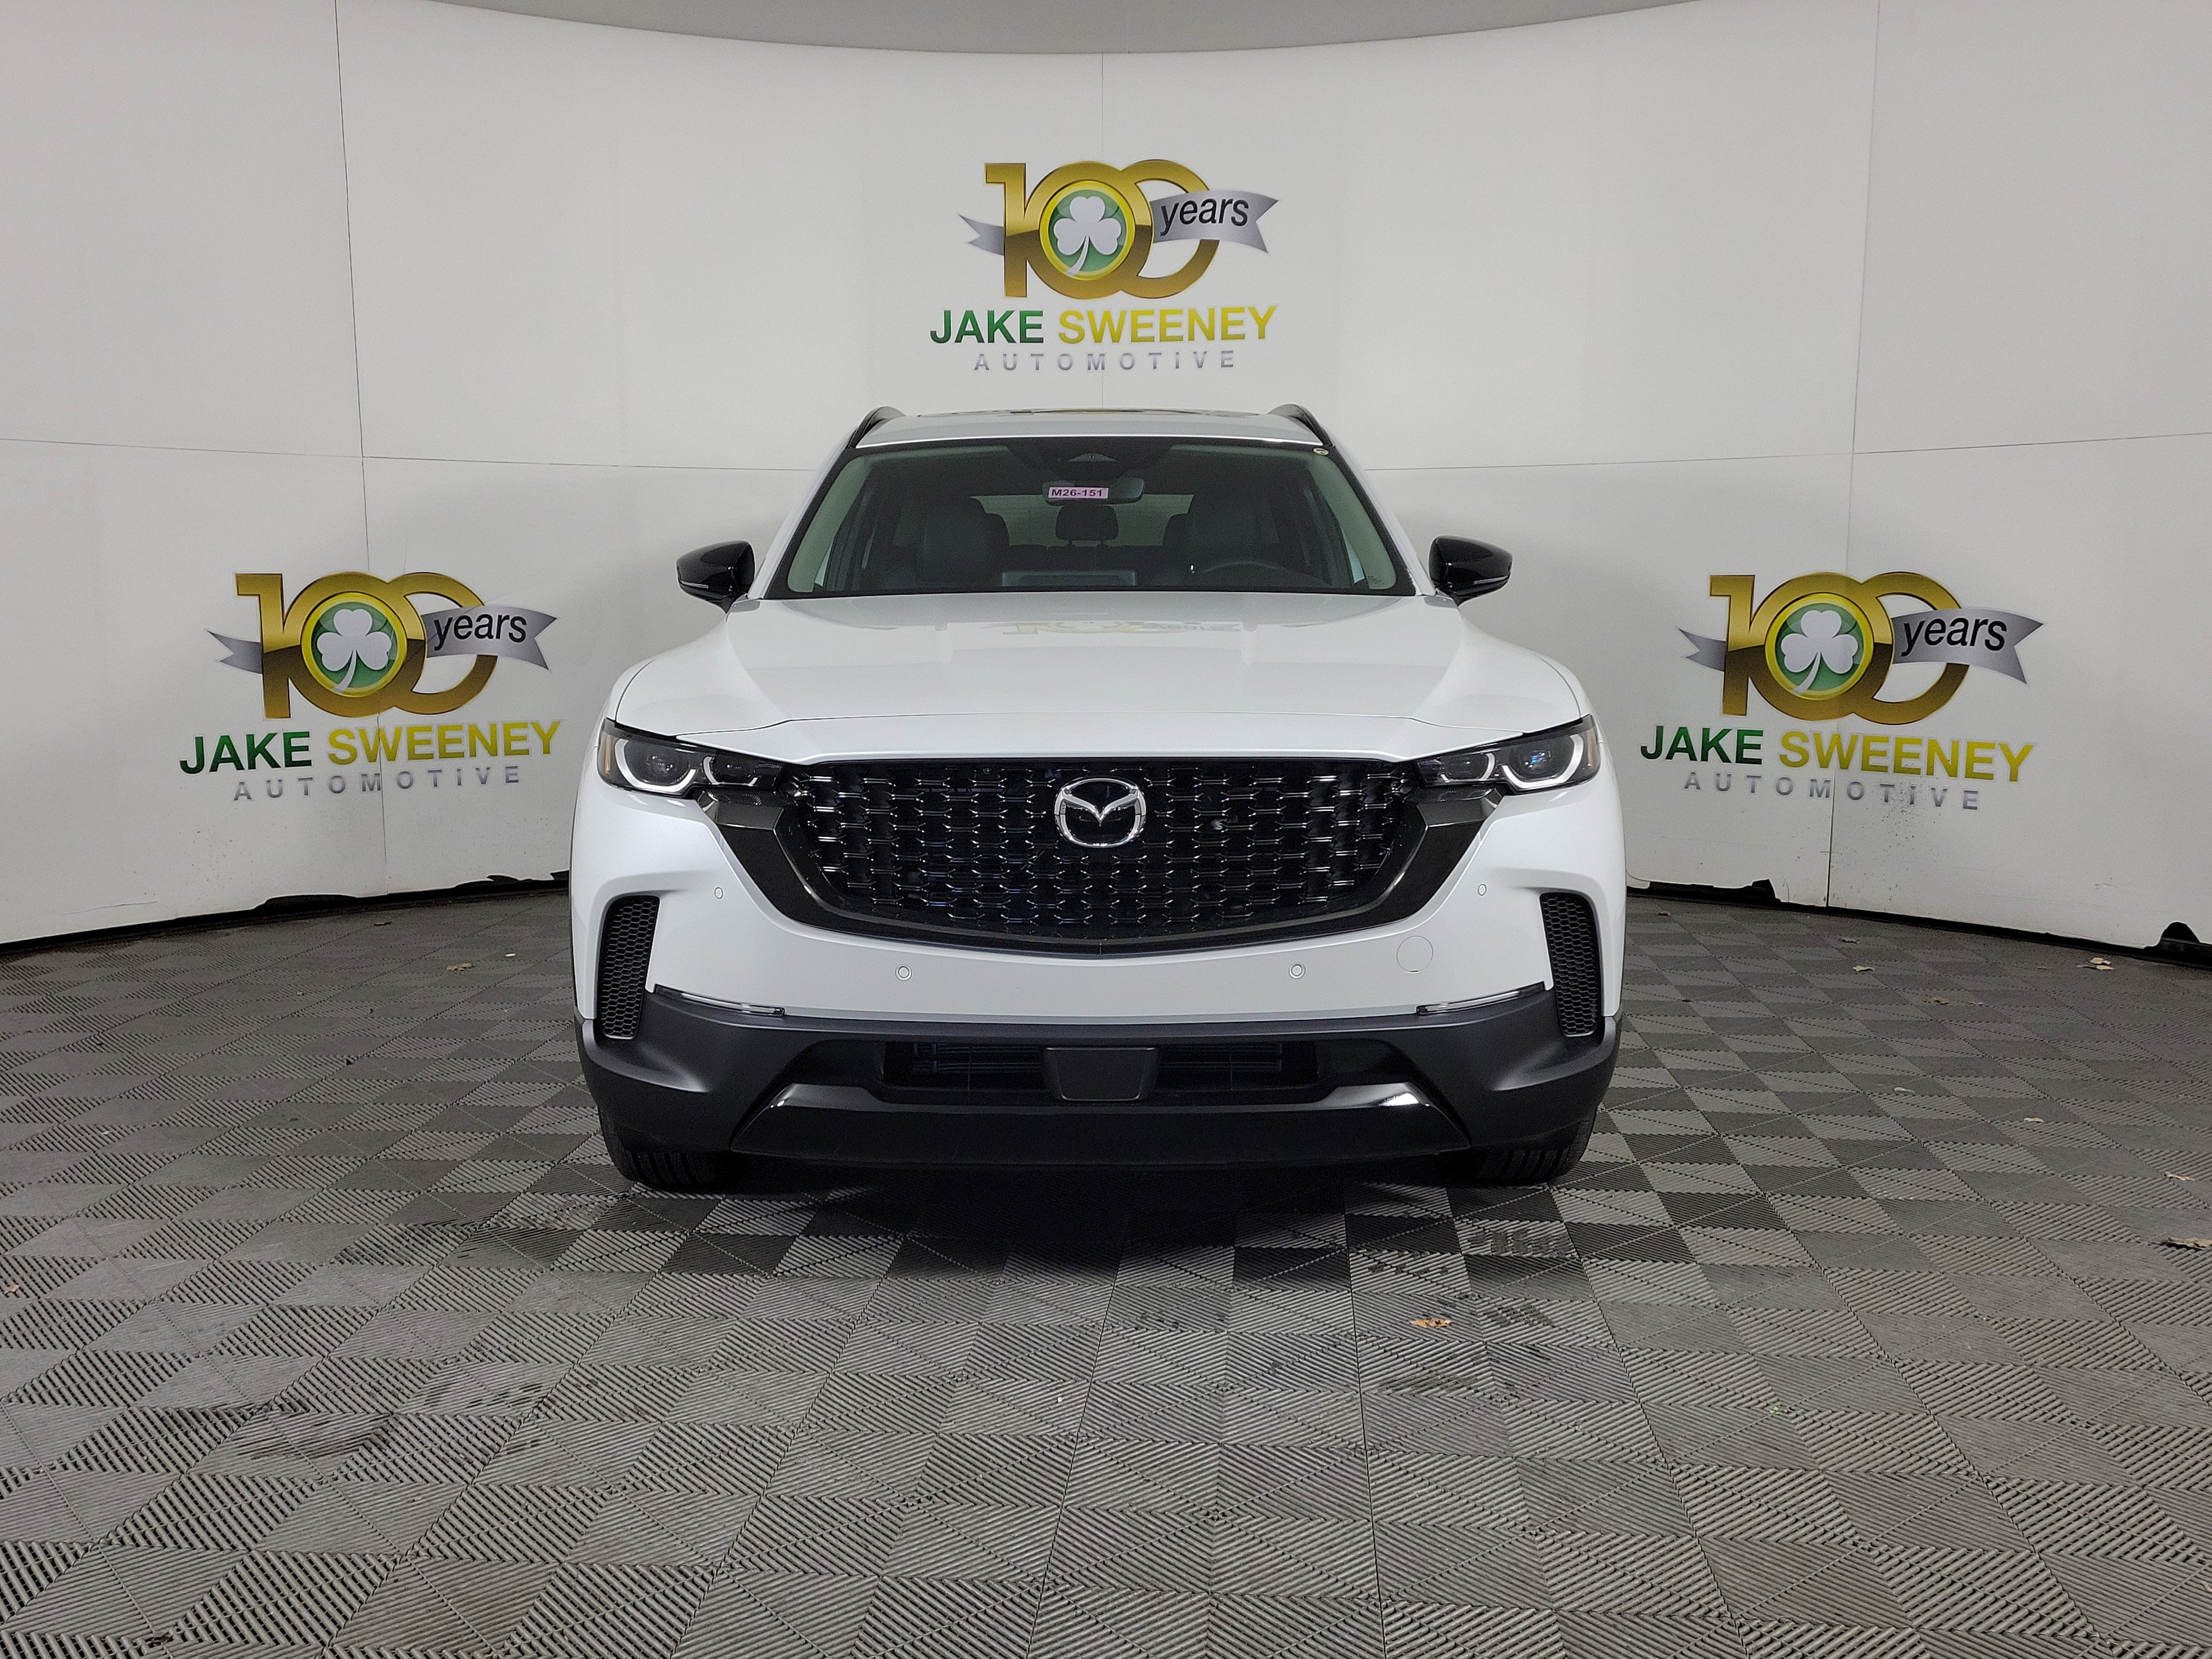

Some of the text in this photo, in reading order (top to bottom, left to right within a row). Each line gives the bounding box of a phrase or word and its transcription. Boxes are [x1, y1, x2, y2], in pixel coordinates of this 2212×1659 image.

[984, 159, 1220, 300] 100
[1160, 198, 1249, 236] years
[930, 305, 1277, 344] JAKE SWEENEY
[974, 350, 1234, 370] AUTOMOTIVE
[235, 572, 497, 718] 100
[433, 611, 527, 651] years
[1709, 572, 1970, 725] 100
[1902, 618, 2007, 656] years
[179, 721, 560, 774] JAKE SWEENEY
[1640, 725, 2034, 782] JAKE SWEENEY
[233, 766, 520, 801] AUTOMOTIVE
[1684, 771, 1978, 810] AUTOMOTIVE
